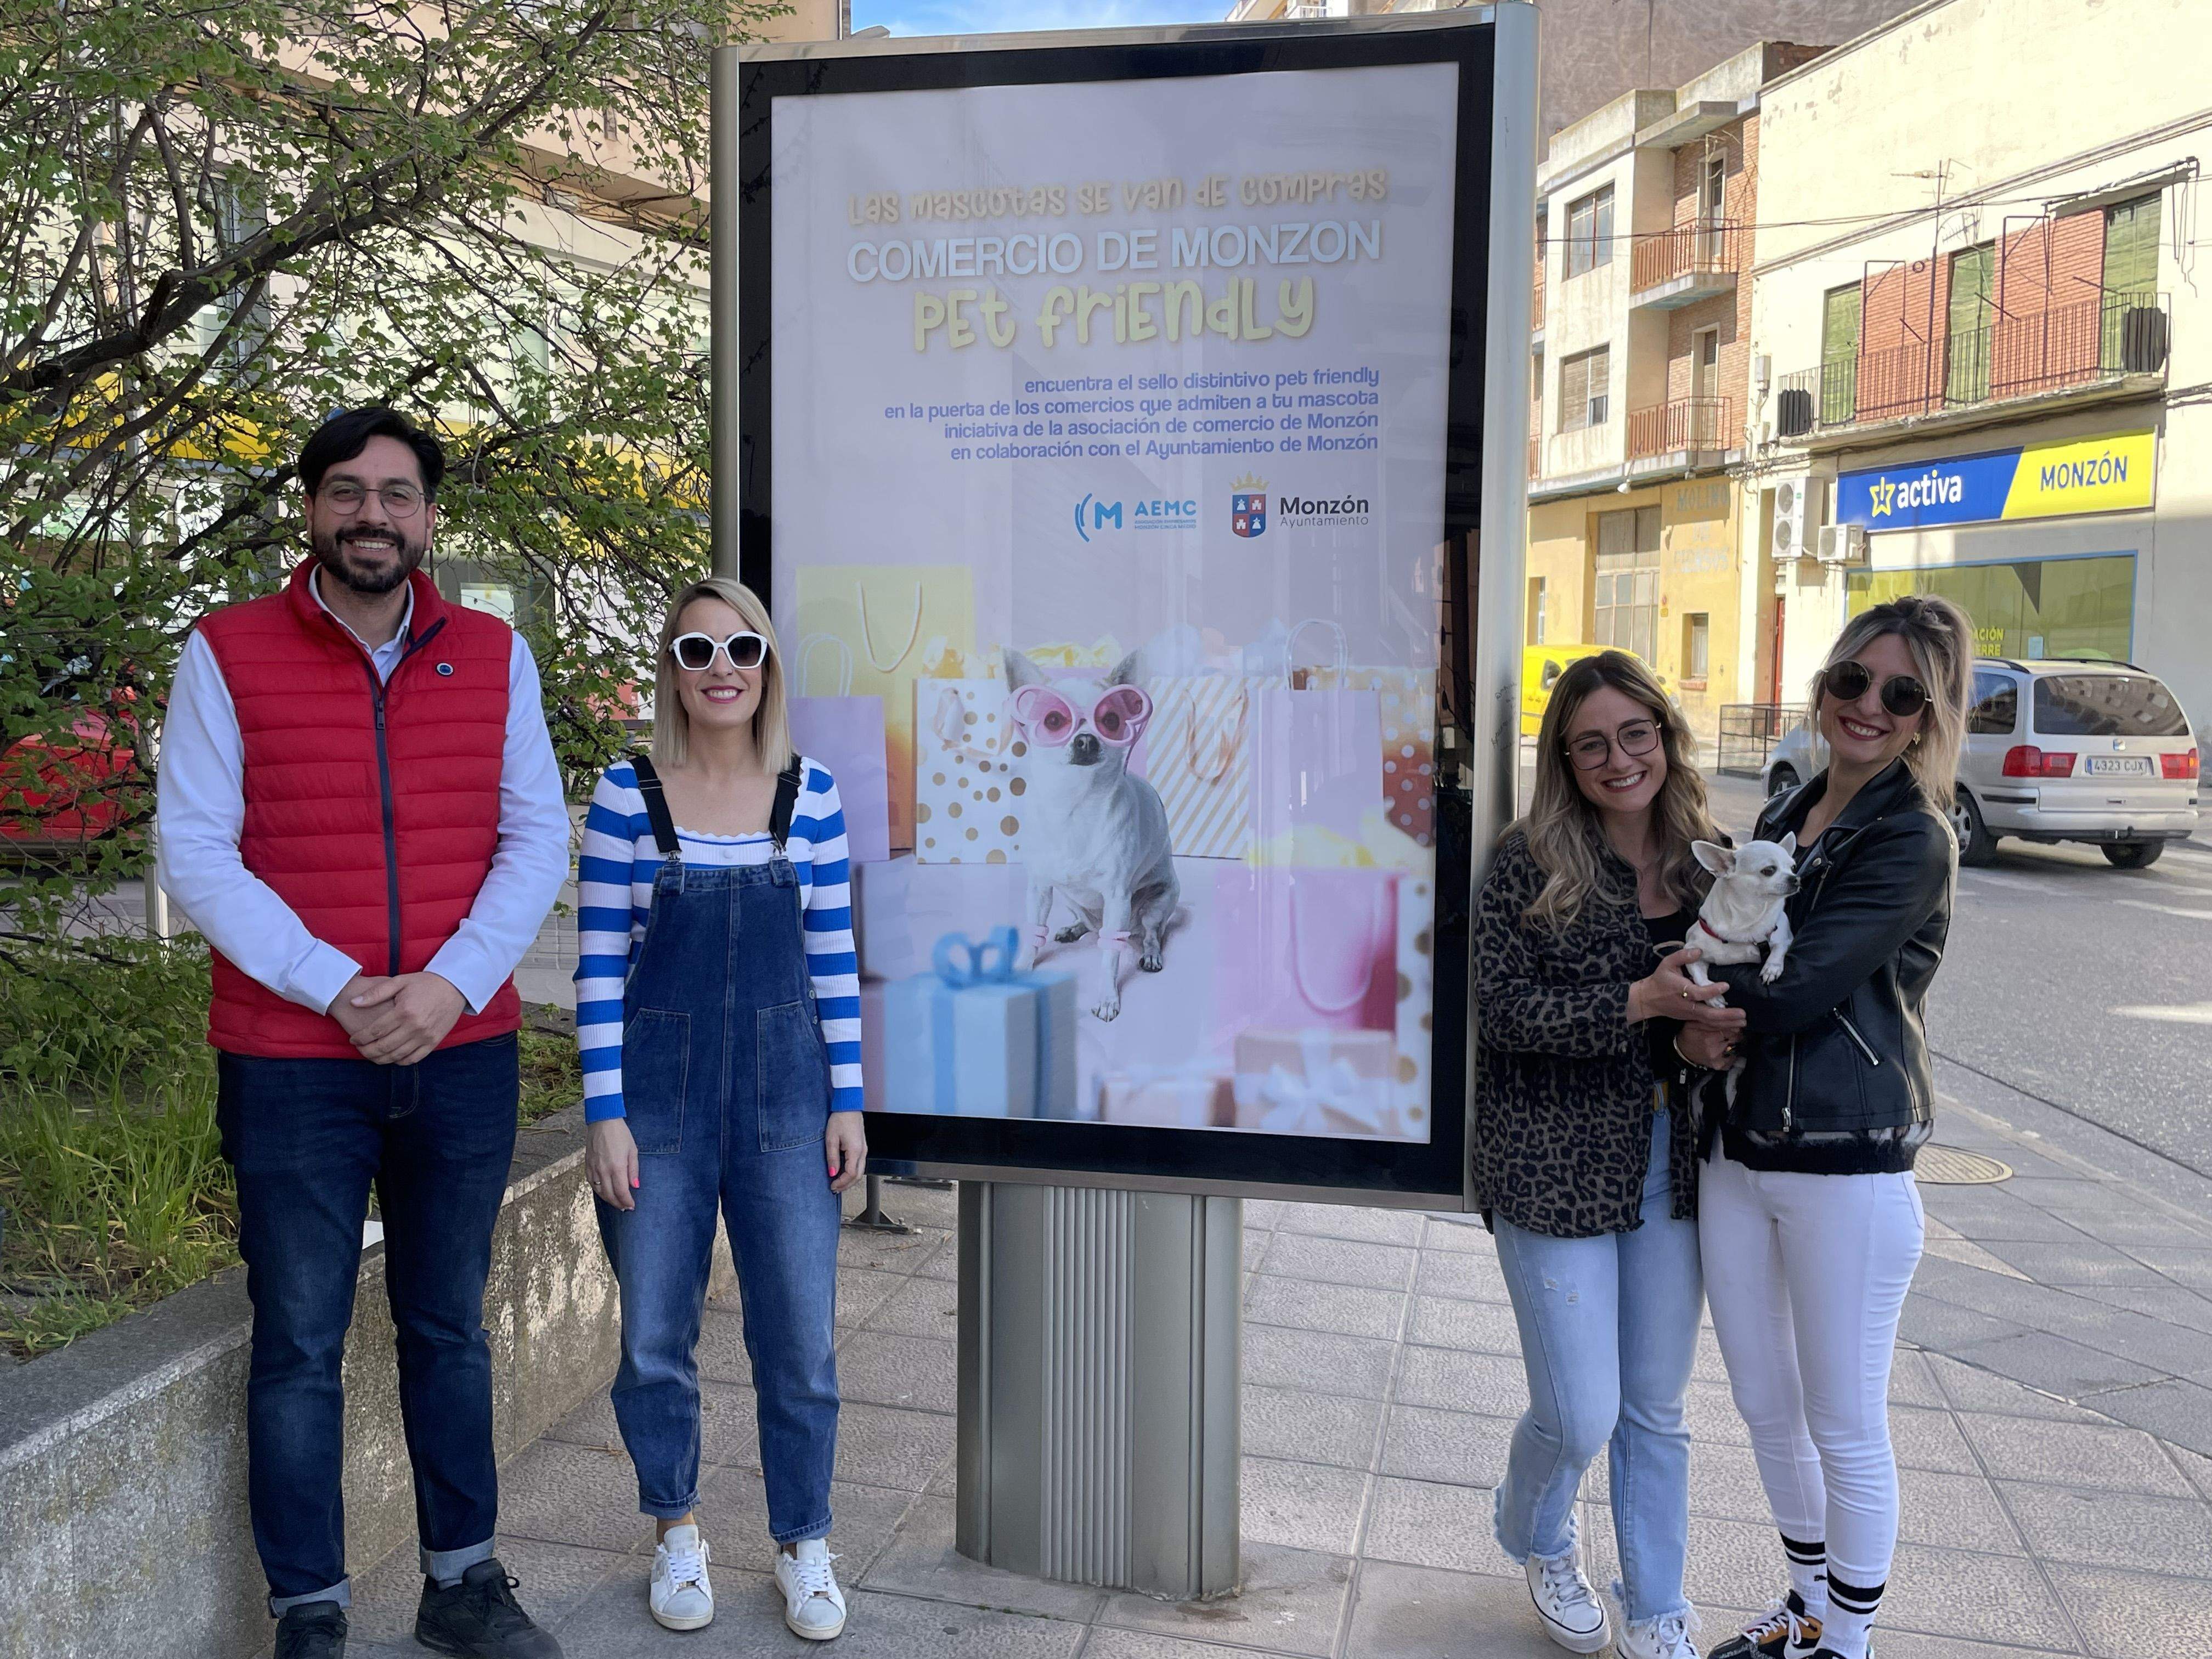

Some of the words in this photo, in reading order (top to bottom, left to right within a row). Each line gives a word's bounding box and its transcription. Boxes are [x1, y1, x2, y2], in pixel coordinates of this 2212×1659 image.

[847, 233, 1084, 283] COMERCIO
[1097, 229, 1158, 271] DE
[1172, 220, 1380, 268] MONZON
[1025, 376, 1113, 393] encuentra
[1118, 374, 1133, 391] el
[1138, 374, 1178, 390] sello
[1183, 371, 1271, 389] distintivo
[1276, 370, 1307, 391] pet
[1314, 367, 1380, 387] friendly
[884, 405, 905, 419] en
[910, 403, 923, 418] la
[929, 402, 985, 422] puerta
[990, 400, 1010, 416] de
[1015, 399, 1040, 415] los
[1045, 397, 1135, 414] comercios
[1139, 398, 1172, 416] que
[1177, 394, 1251, 410] admiten
[1256, 396, 1267, 409] a
[1272, 393, 1293, 408] tu
[1298, 391, 1379, 408] mascota
[944, 422, 1018, 439] iniciativa
[1023, 421, 1043, 436] de
[1049, 420, 1063, 436] la
[1068, 417, 1160, 435] asociación
[1165, 417, 1187, 433] de
[1193, 415, 1274, 432] comercio
[1280, 414, 1302, 430] de
[1307, 411, 1378, 429] Monzón
[951, 447, 970, 460] en
[976, 441, 1083, 459] colaboración
[1088, 443, 1120, 458] con
[1125, 440, 1140, 456] el
[1146, 438, 1274, 460] Ayuntamiento
[1280, 437, 1301, 452] de
[1307, 433, 1378, 452] Monzón
[1897, 469, 1962, 509] activa
[2040, 451, 2128, 492] MONZÓN
[1135, 500, 1197, 516] AEMC
[1280, 494, 1369, 515] Monzón
[1280, 516, 1369, 528] Ayuntamiento
[2094, 760, 2121, 771] 4323
